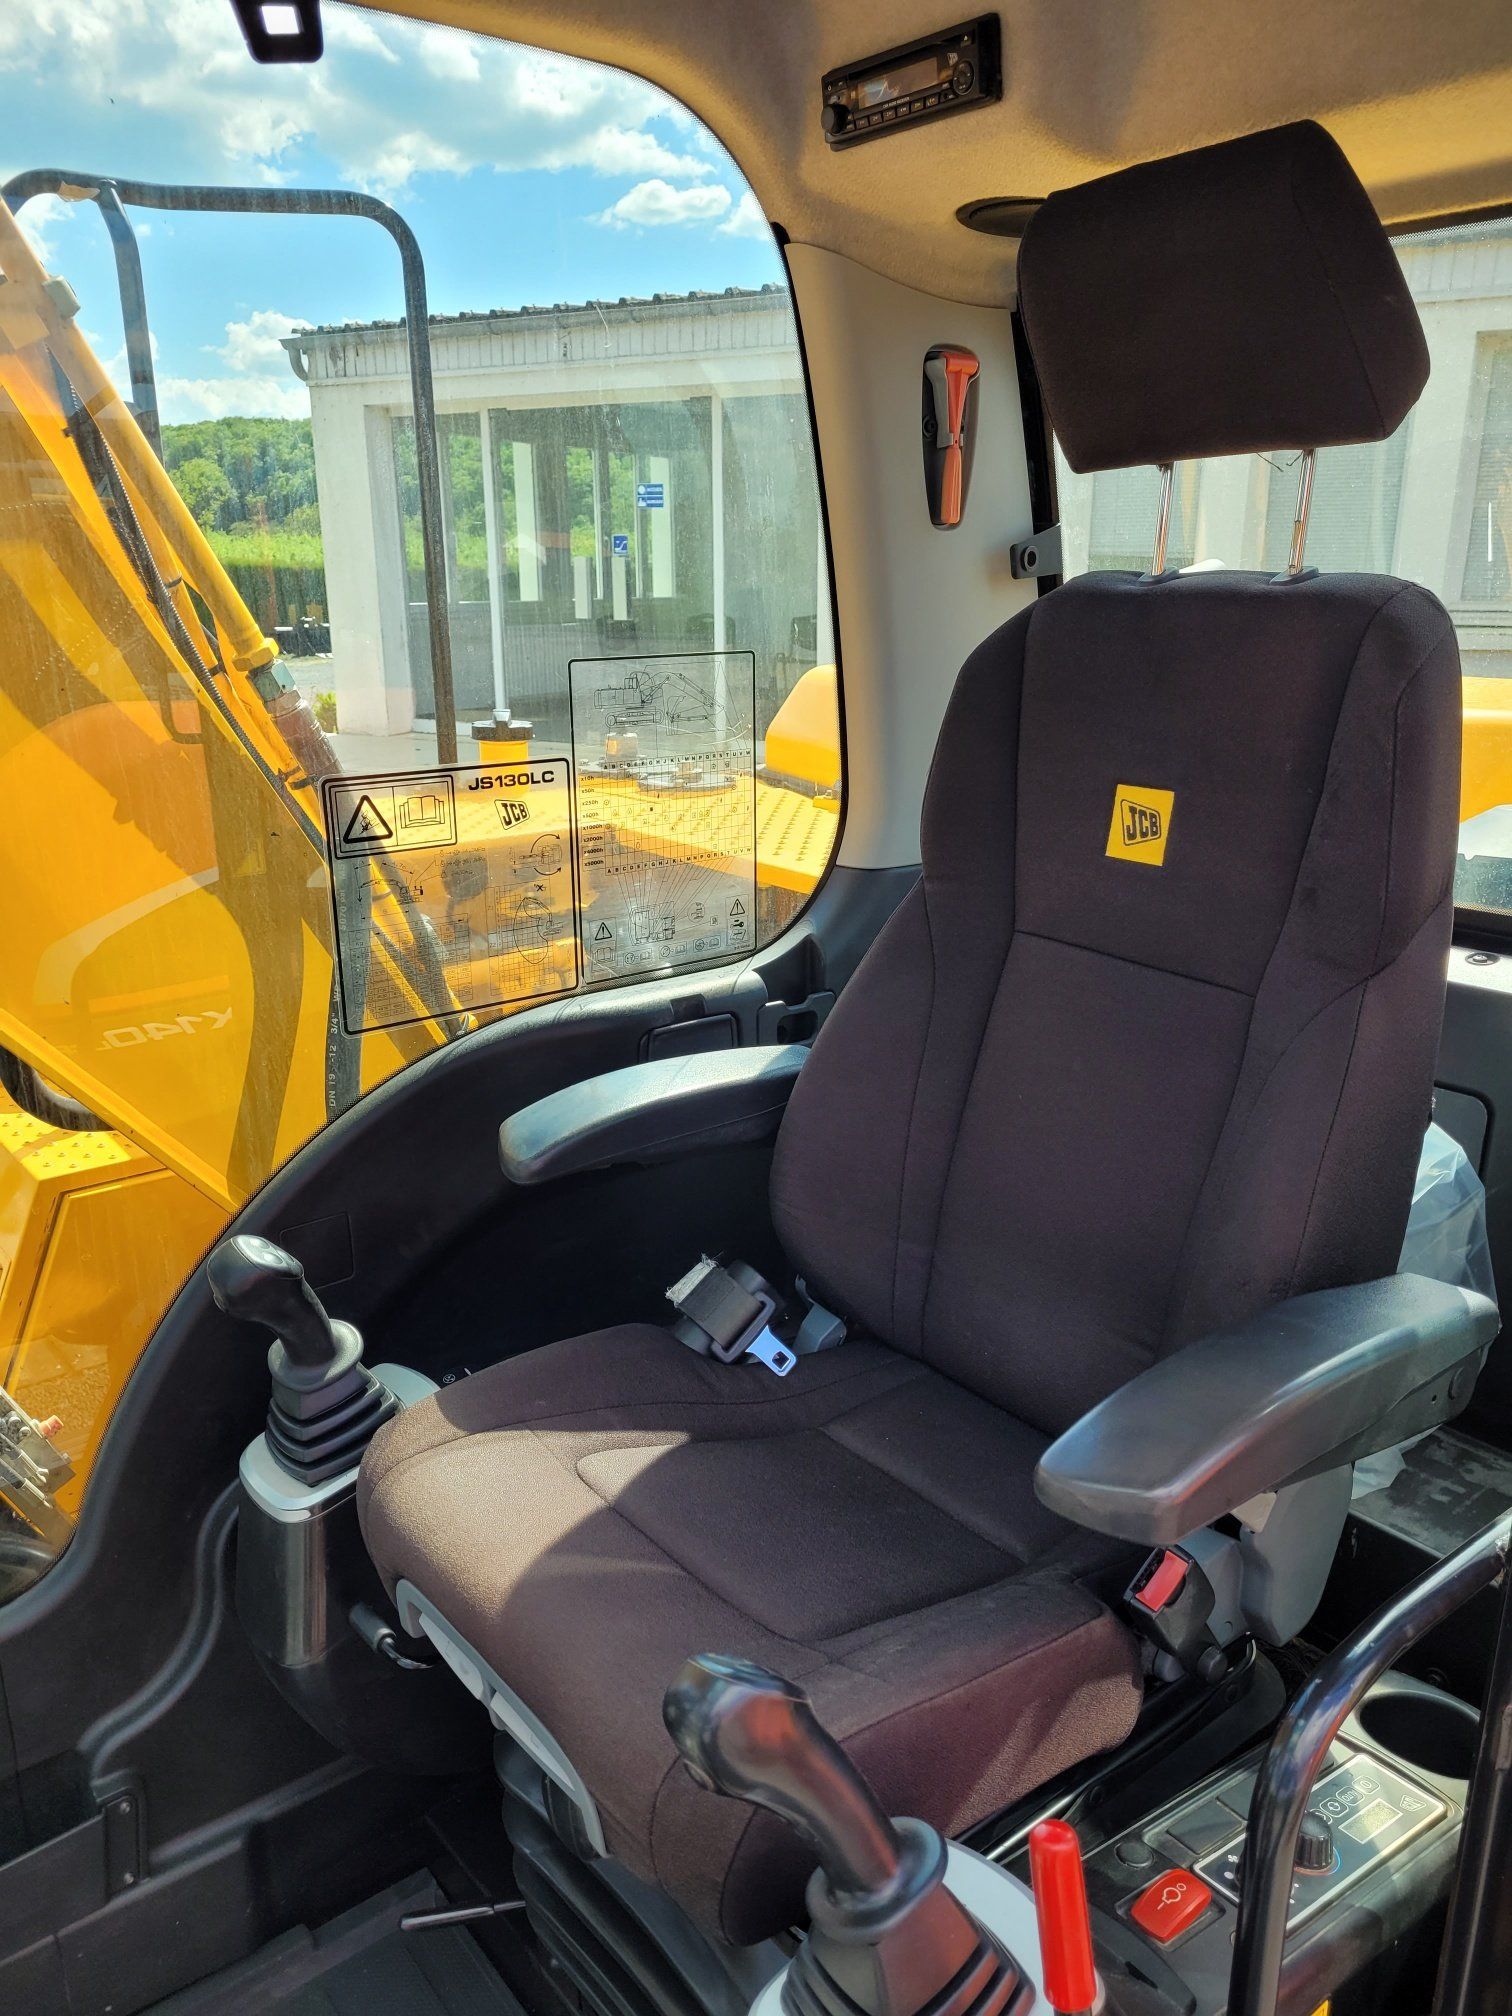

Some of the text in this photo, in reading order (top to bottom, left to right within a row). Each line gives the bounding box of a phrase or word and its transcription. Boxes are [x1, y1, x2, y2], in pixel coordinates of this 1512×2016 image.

[468, 770, 554, 790] JS130LC
[500, 802, 528, 827] JCB
[1126, 805, 1159, 842] JCB
[329, 1090, 336, 1107] DN
